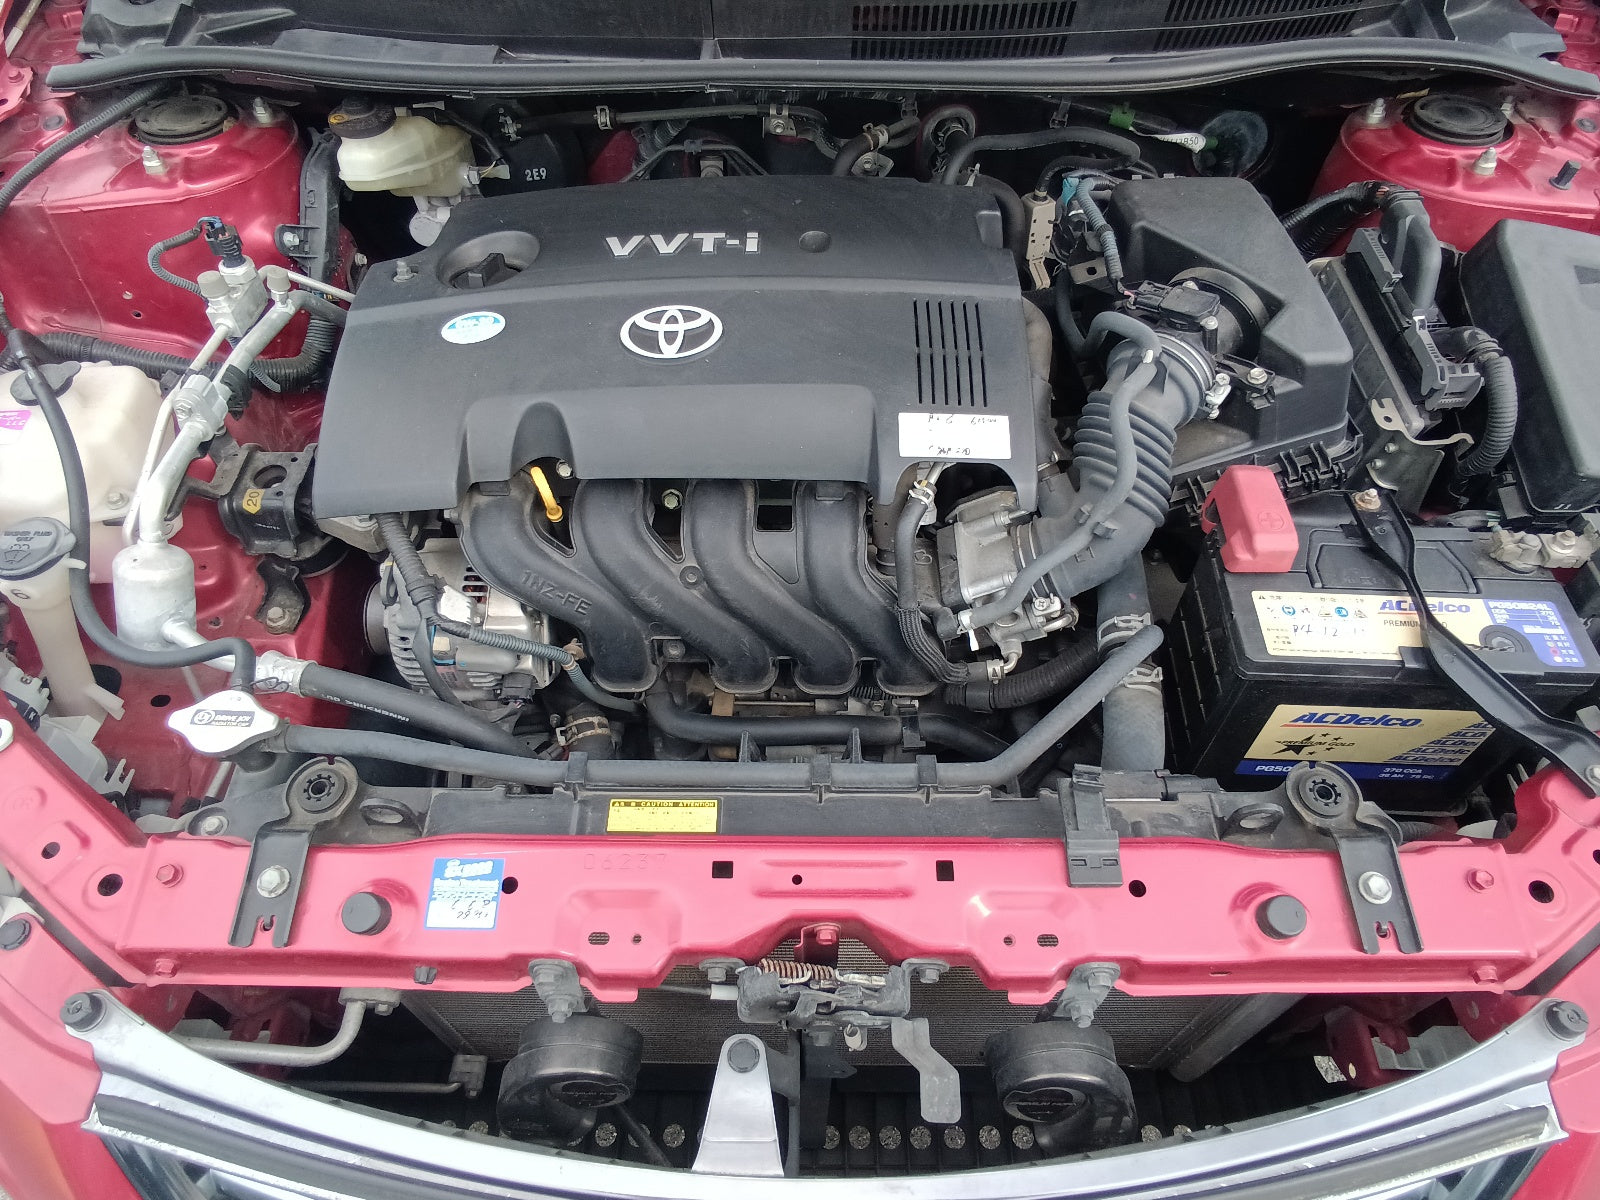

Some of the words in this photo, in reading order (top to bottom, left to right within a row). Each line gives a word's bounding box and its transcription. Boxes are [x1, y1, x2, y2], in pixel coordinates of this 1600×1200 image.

[524, 167, 547, 182] 2E9
[605, 232, 759, 256] VVT-i
[246, 491, 260, 507] 20
[1290, 712, 1422, 727] ACDelco
[1387, 755, 1462, 763] ACDelco
